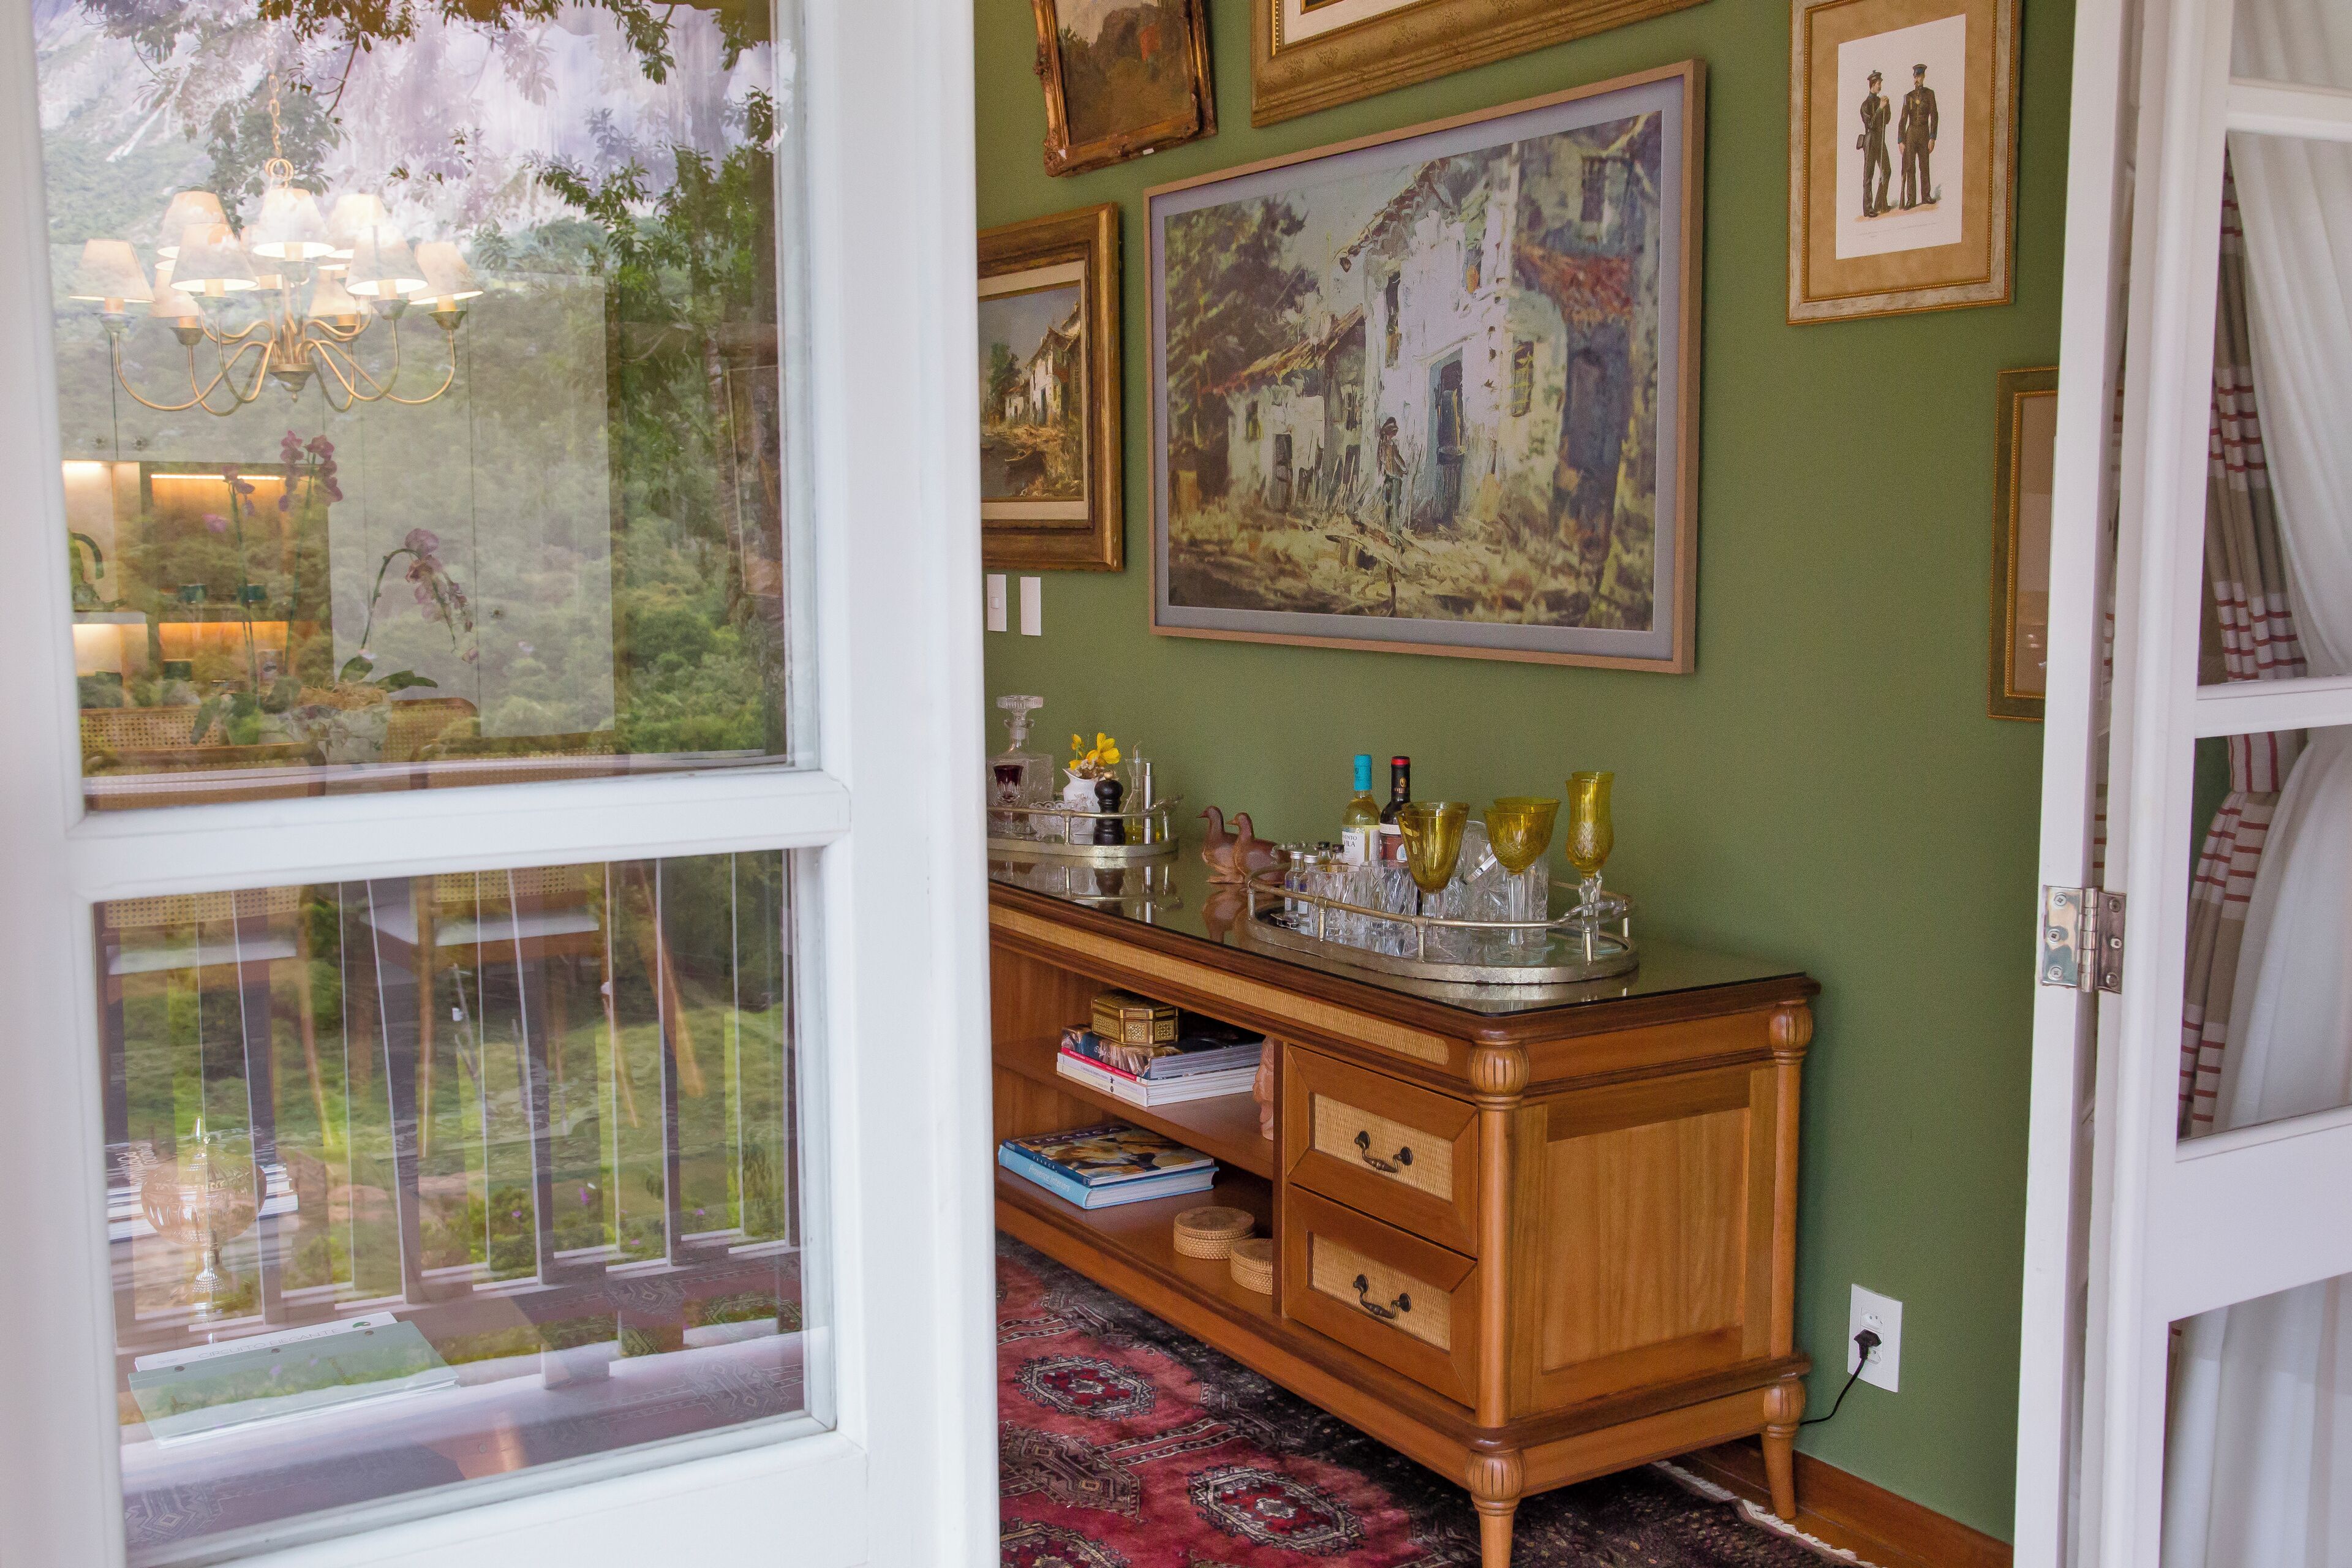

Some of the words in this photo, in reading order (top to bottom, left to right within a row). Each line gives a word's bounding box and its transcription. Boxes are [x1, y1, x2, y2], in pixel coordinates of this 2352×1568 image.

[1028, 1164, 1049, 1182] Provence
[1050, 1175, 1071, 1193] Interiors
[198, 1343, 266, 1358] CIRCUITO
